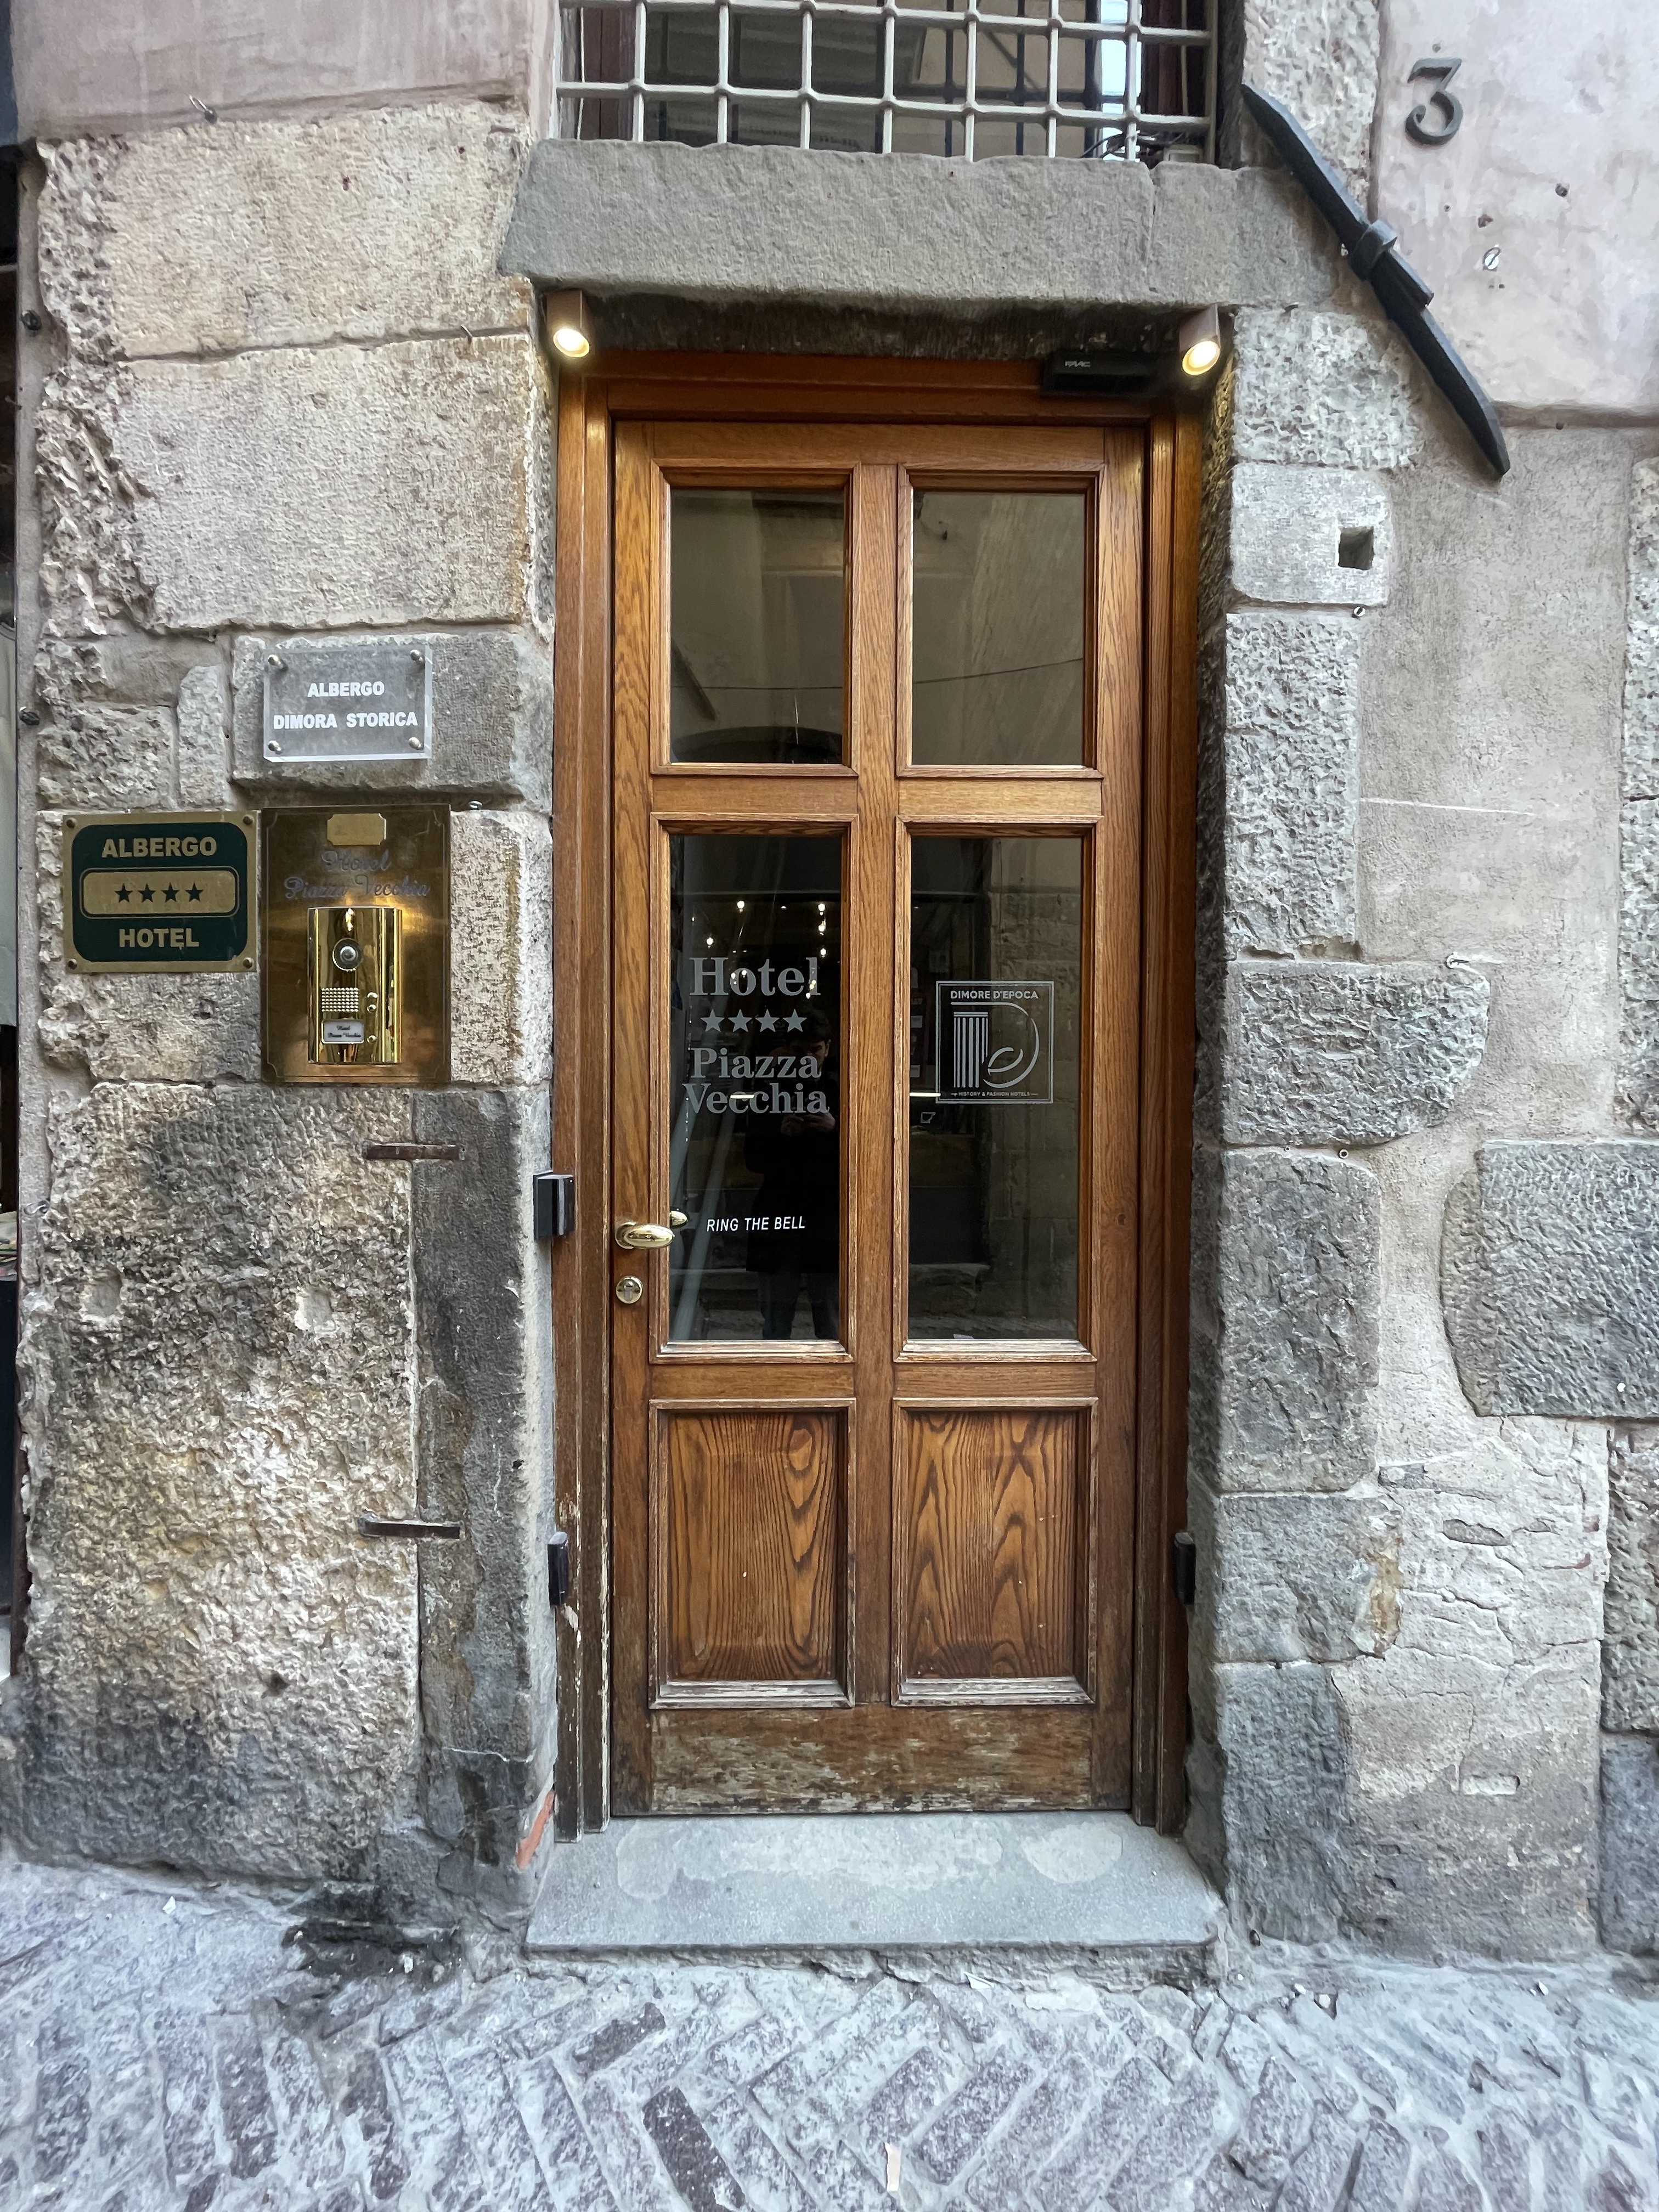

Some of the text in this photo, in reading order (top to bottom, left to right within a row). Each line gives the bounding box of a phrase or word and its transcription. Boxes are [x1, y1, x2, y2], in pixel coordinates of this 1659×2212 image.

[1405, 58, 1463, 146] 3
[307, 681, 385, 697] ALBERGO
[273, 712, 417, 729] DIMORA STORICA
[101, 836, 217, 858] ALBERGO
[321, 849, 392, 871] Hotel
[284, 874, 430, 899] Piazza Vecchia
[119, 928, 200, 948] HOTEL
[689, 957, 821, 996] Hotel
[950, 990, 1039, 999] DIMORE D'EPOCA
[690, 1047, 822, 1079] Piazza
[681, 1082, 830, 1114] Vecchia
[707, 1216, 805, 1232] RING THE BELL
